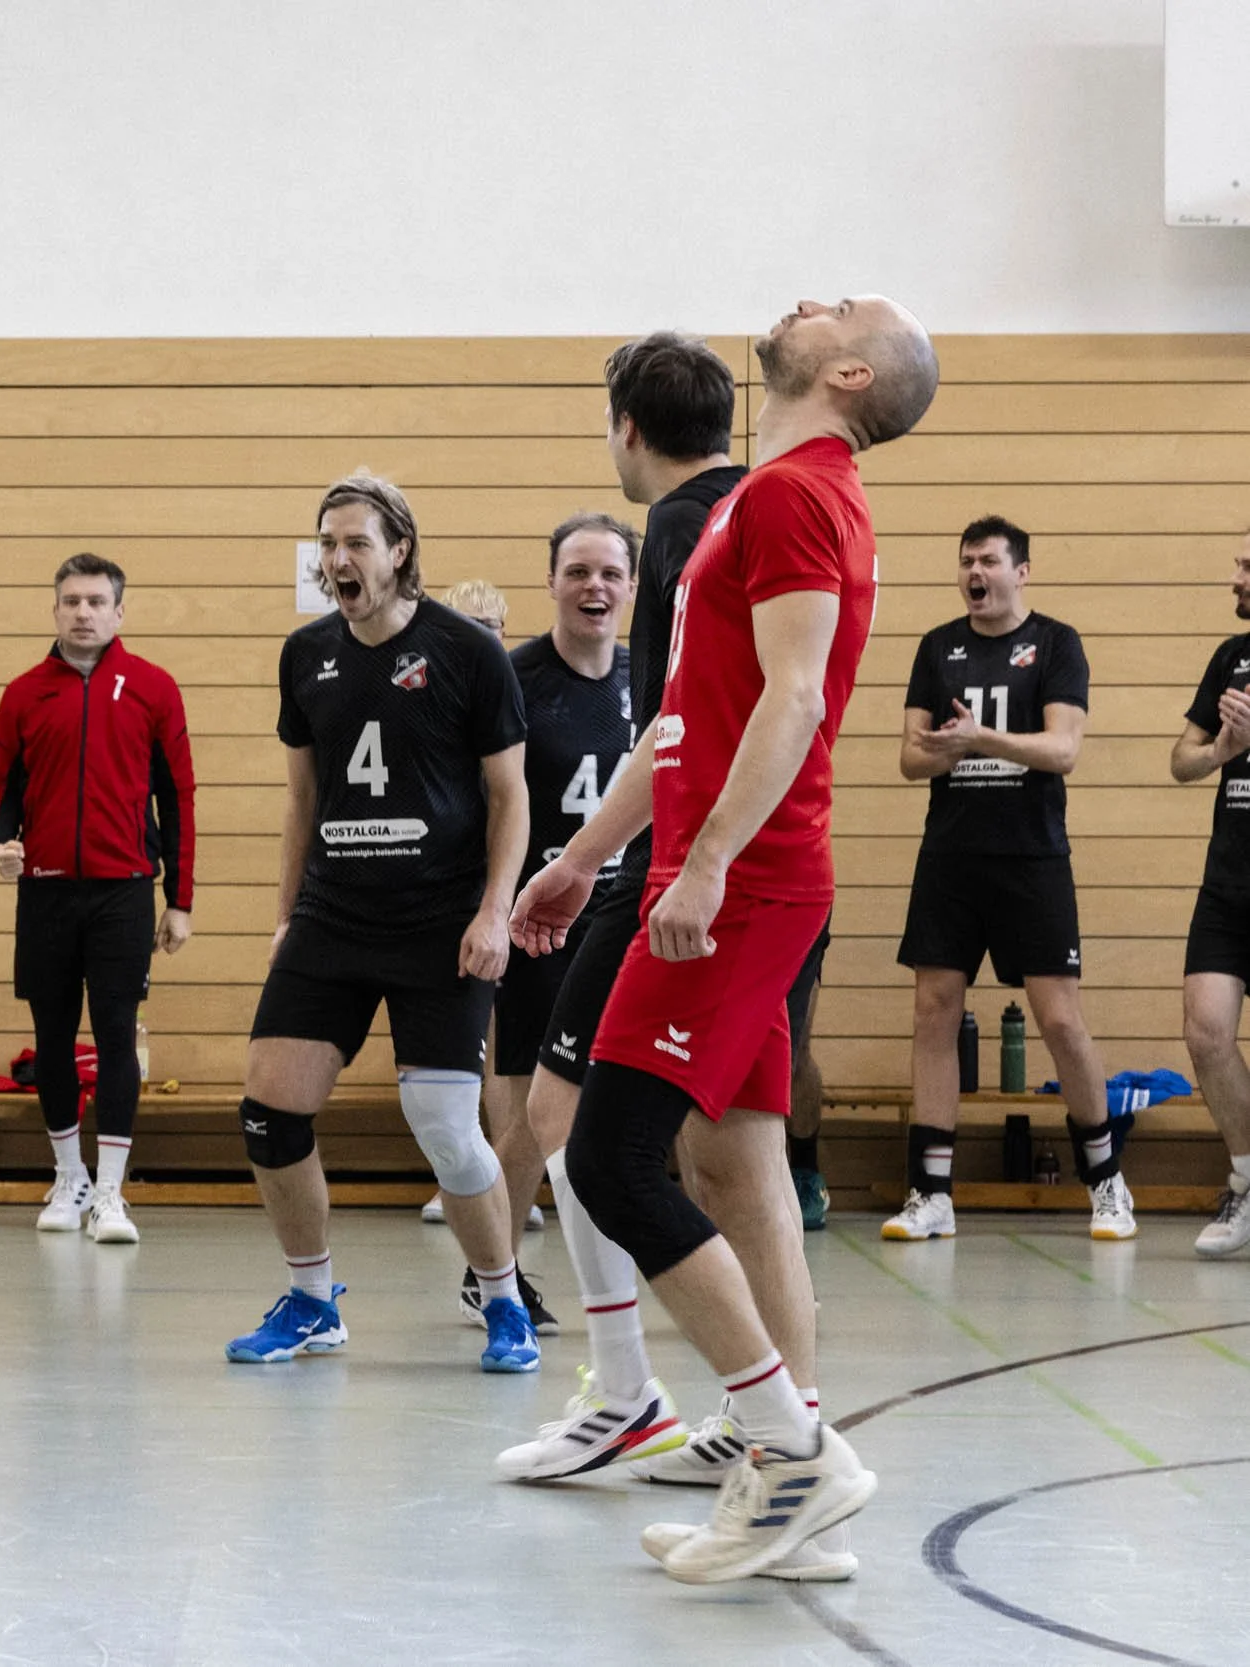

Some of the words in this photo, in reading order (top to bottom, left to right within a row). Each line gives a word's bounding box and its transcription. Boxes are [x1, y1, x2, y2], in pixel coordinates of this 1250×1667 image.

[964, 685, 1009, 732] 11
[346, 720, 389, 797] 4
[324, 825, 391, 838] NOSTALGIA
[552, 1042, 577, 1062] erima
[653, 1038, 692, 1062] erima
